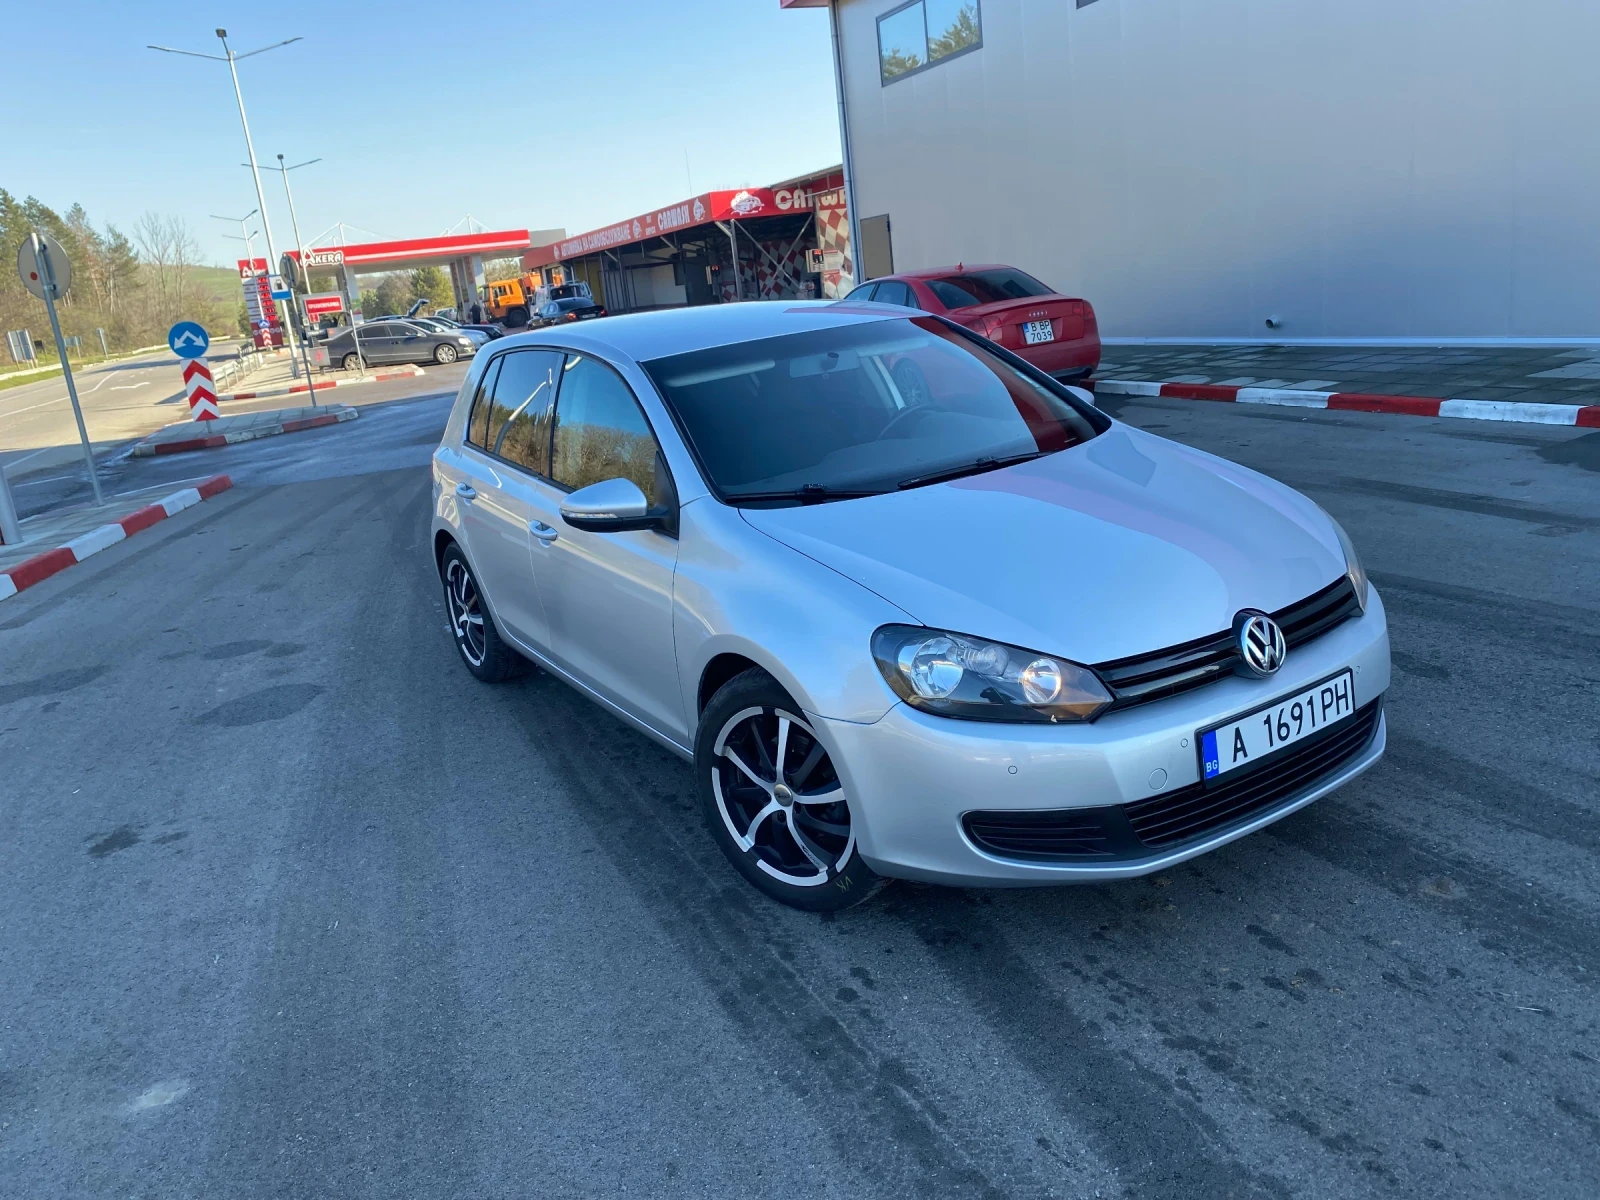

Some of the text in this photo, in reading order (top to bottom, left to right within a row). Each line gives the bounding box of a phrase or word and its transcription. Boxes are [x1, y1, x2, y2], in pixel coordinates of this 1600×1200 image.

[658, 204, 690, 230] CARWASH
[300, 248, 343, 266] AKERA
[1031, 321, 1050, 331] B BP
[1031, 331, 1052, 342] 7039
[1232, 726, 1248, 763] A
[1206, 759, 1219, 773] BG
